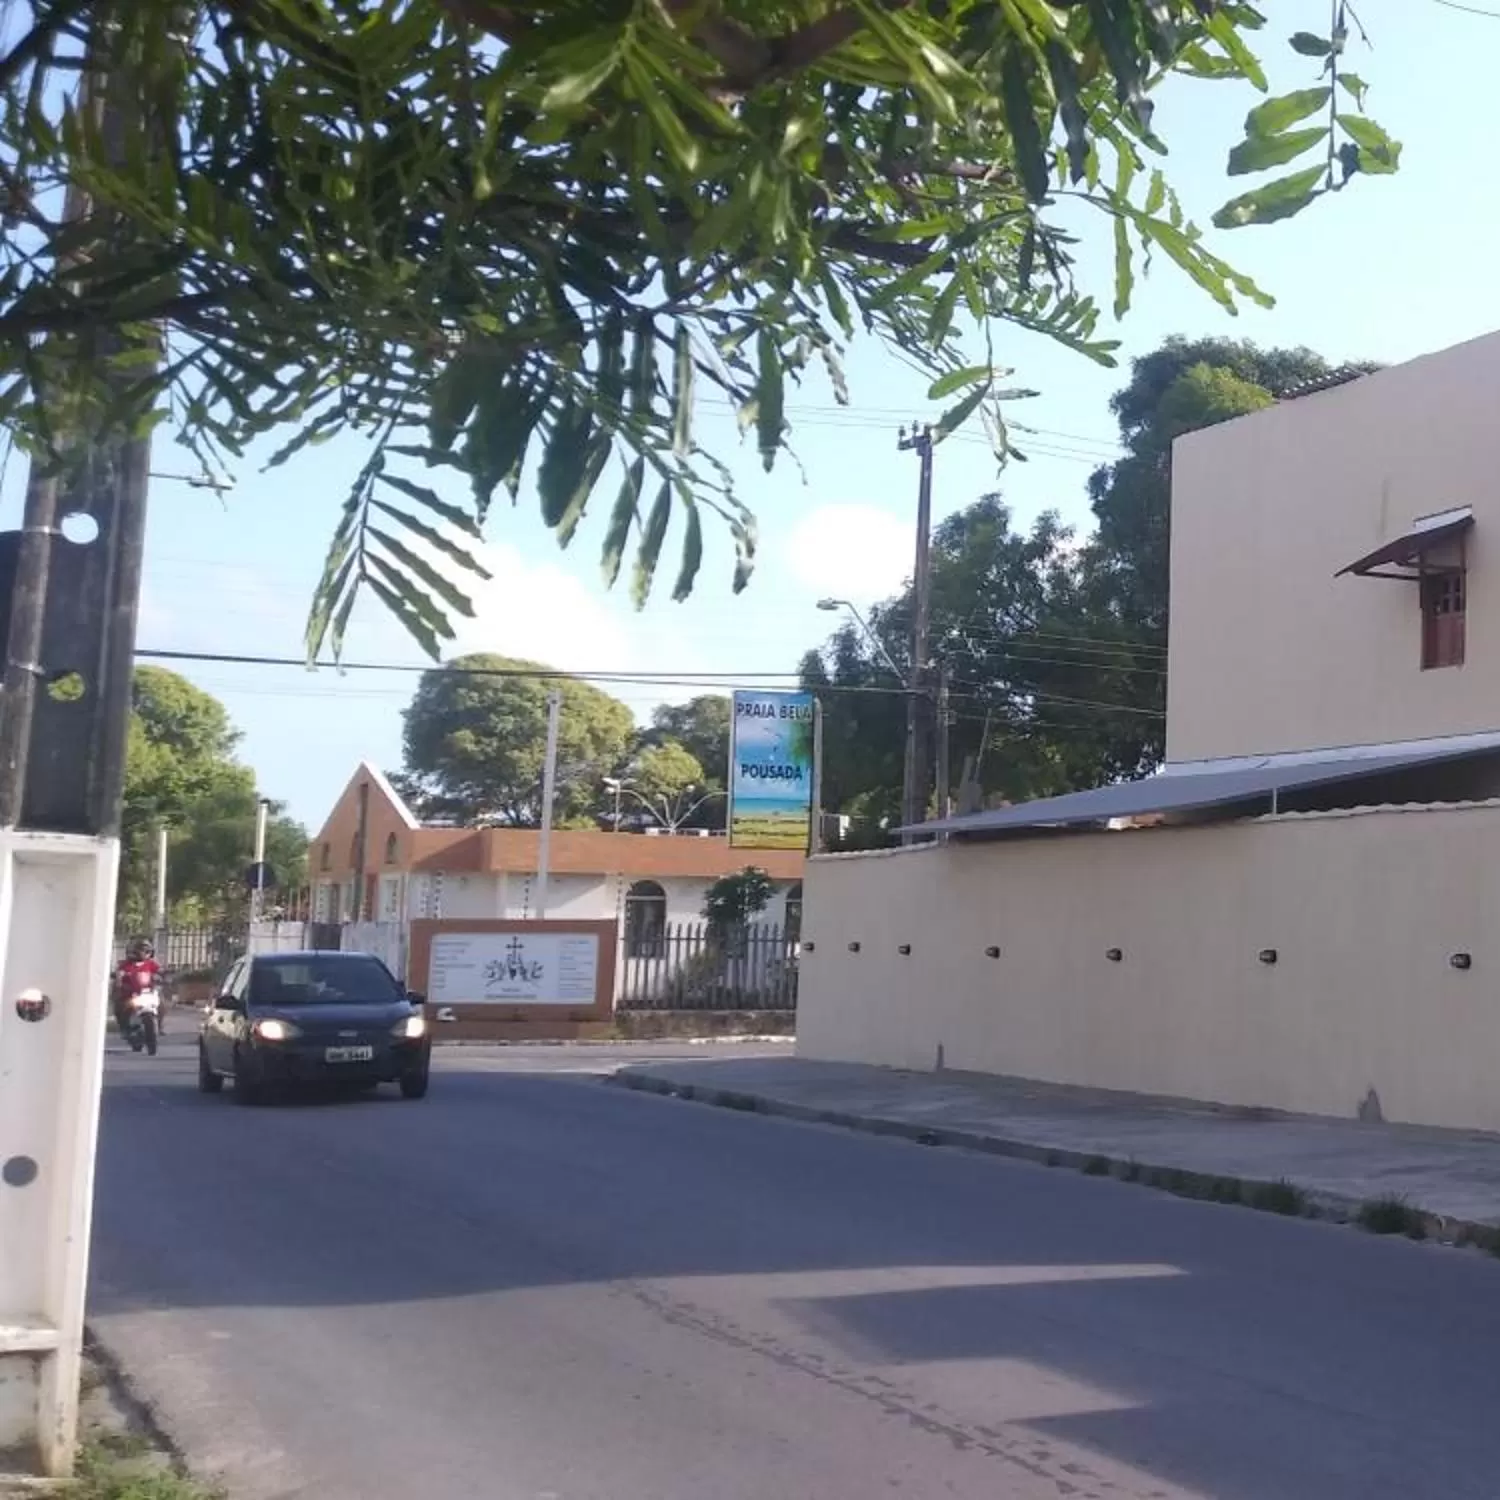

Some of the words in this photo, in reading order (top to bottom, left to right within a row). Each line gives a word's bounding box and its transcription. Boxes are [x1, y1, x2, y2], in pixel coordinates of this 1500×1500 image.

[736, 703, 776, 718] PRAIA
[779, 704, 812, 719] BELA
[741, 763, 803, 779] POUSADA
